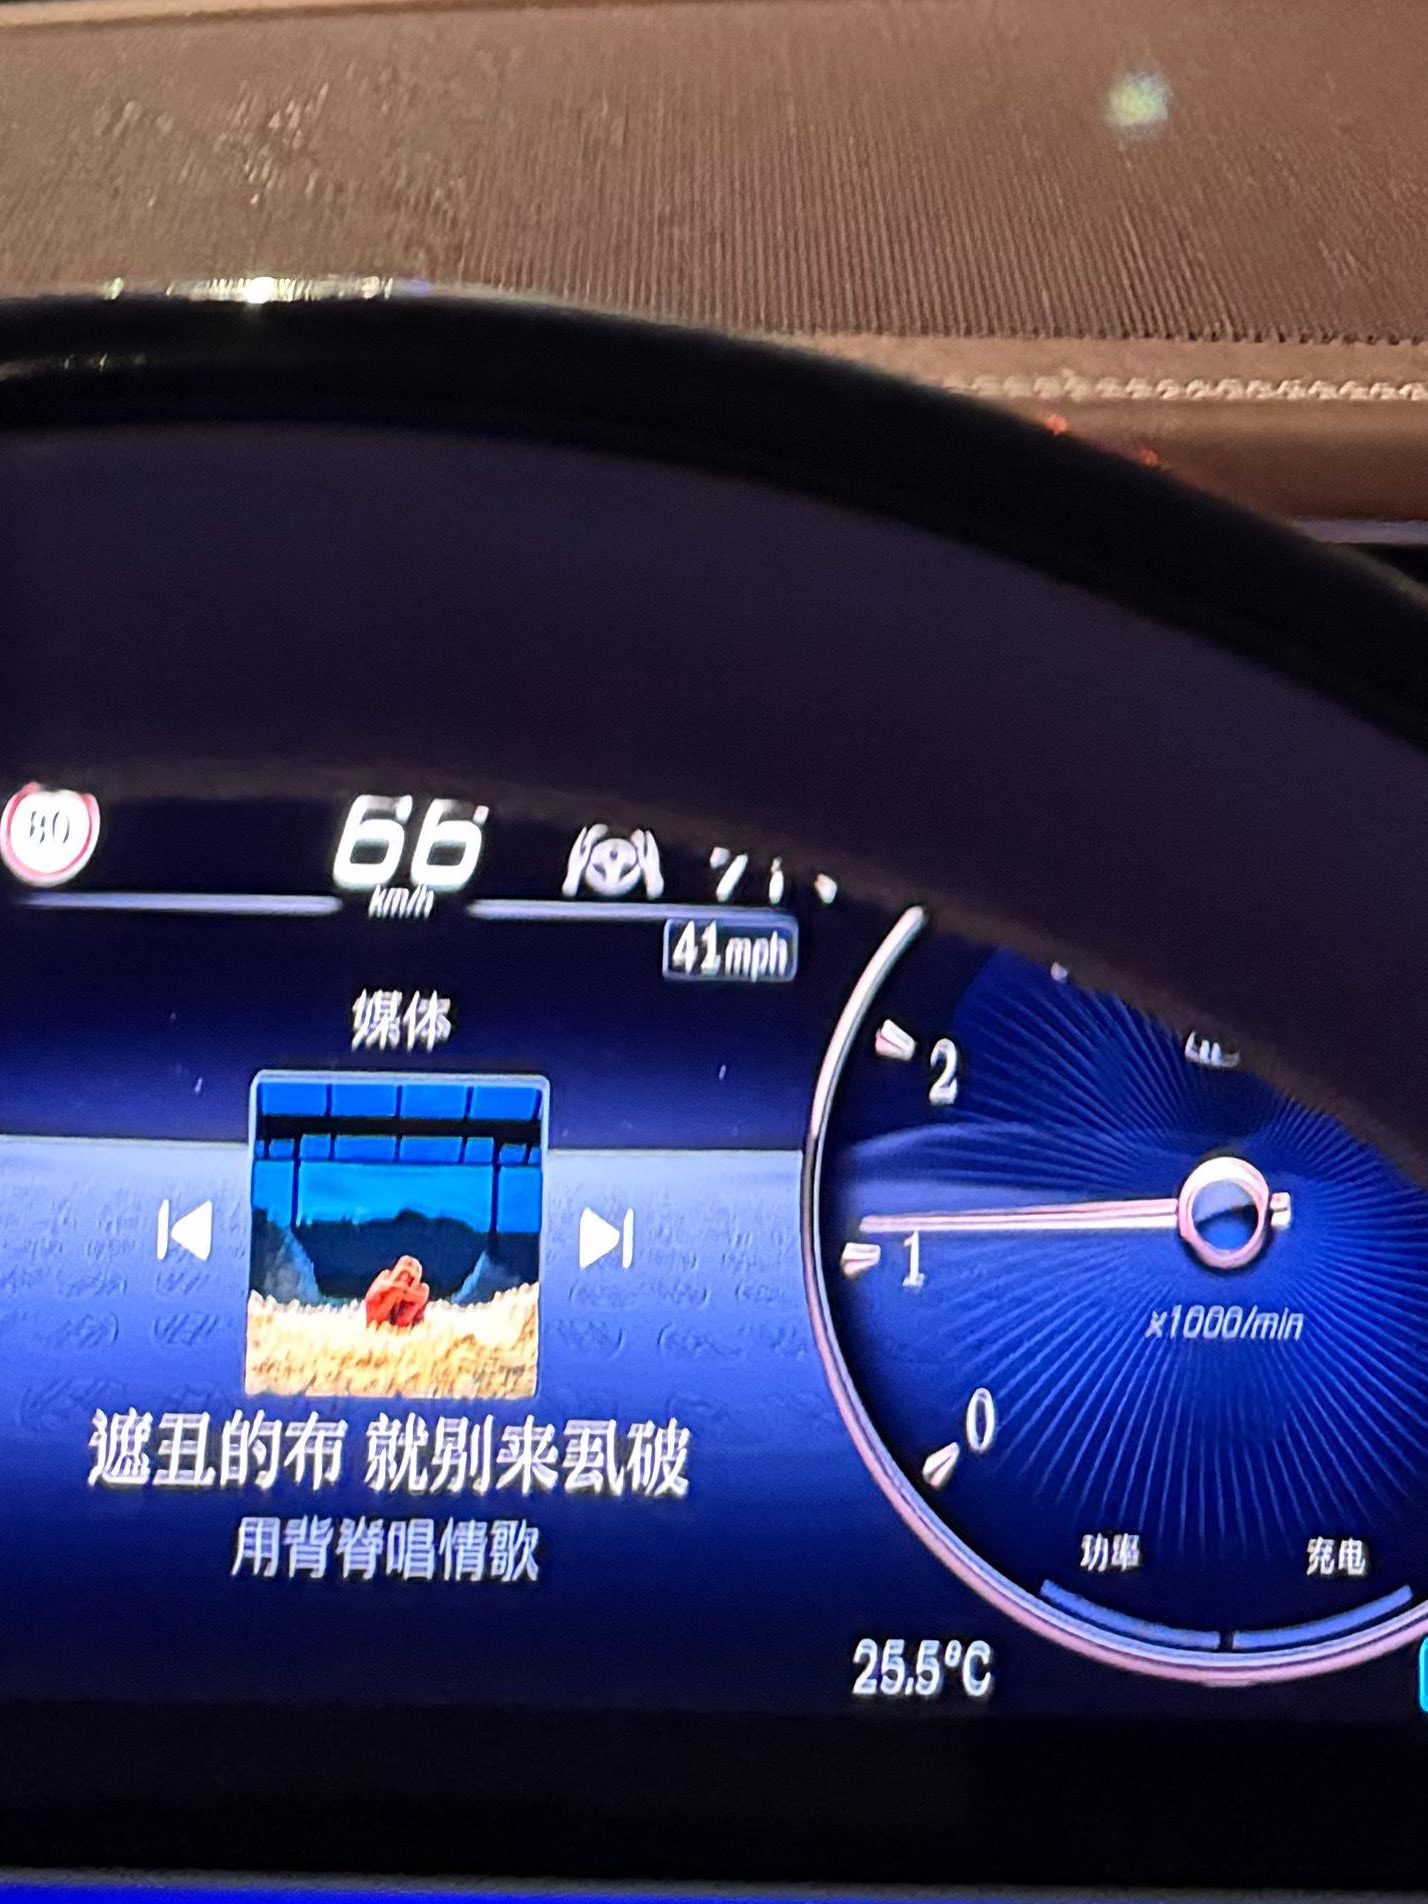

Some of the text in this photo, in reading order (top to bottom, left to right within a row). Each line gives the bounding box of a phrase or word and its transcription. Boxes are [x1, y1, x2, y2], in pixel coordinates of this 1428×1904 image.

[29, 810, 70, 845] 80
[333, 794, 489, 890] 66
[368, 884, 434, 920] km/h
[351, 989, 451, 1052] 媒体
[929, 1038, 957, 1105] 2
[902, 1231, 925, 1287] 1
[1145, 1304, 1304, 1341] x1000/min
[87, 1406, 348, 1490] 遮丑的布
[966, 1388, 996, 1452] 0
[230, 1514, 540, 1582] 用背脊唱情歌
[1080, 1533, 1140, 1572] 功率
[1306, 1537, 1367, 1576] 充电
[852, 1637, 993, 1697] 25.5°C
